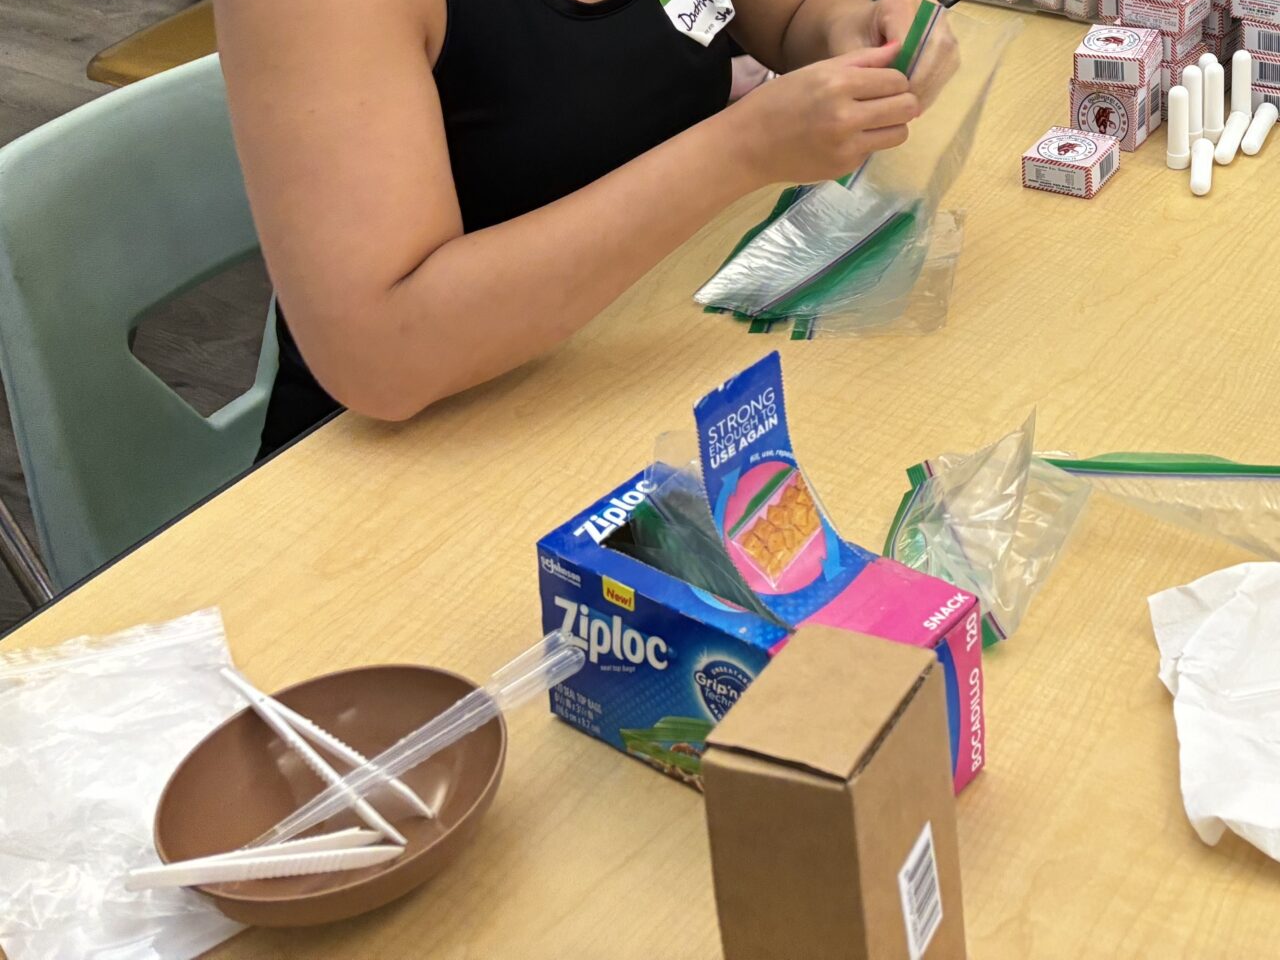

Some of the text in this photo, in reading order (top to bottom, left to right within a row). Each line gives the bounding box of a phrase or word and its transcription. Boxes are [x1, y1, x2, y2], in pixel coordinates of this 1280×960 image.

[708, 387, 775, 445] STRONG
[709, 403, 776, 457] ENOUGH TO
[710, 413, 778, 470] USE AGAIN
[572, 479, 658, 545] Ziploc
[605, 587, 632, 607] New!
[923, 592, 970, 632] SNACK
[554, 595, 668, 671] Ziploc
[966, 612, 978, 652] 120
[695, 672, 738, 700] Grip'n
[969, 667, 984, 772] BOCADILLO
